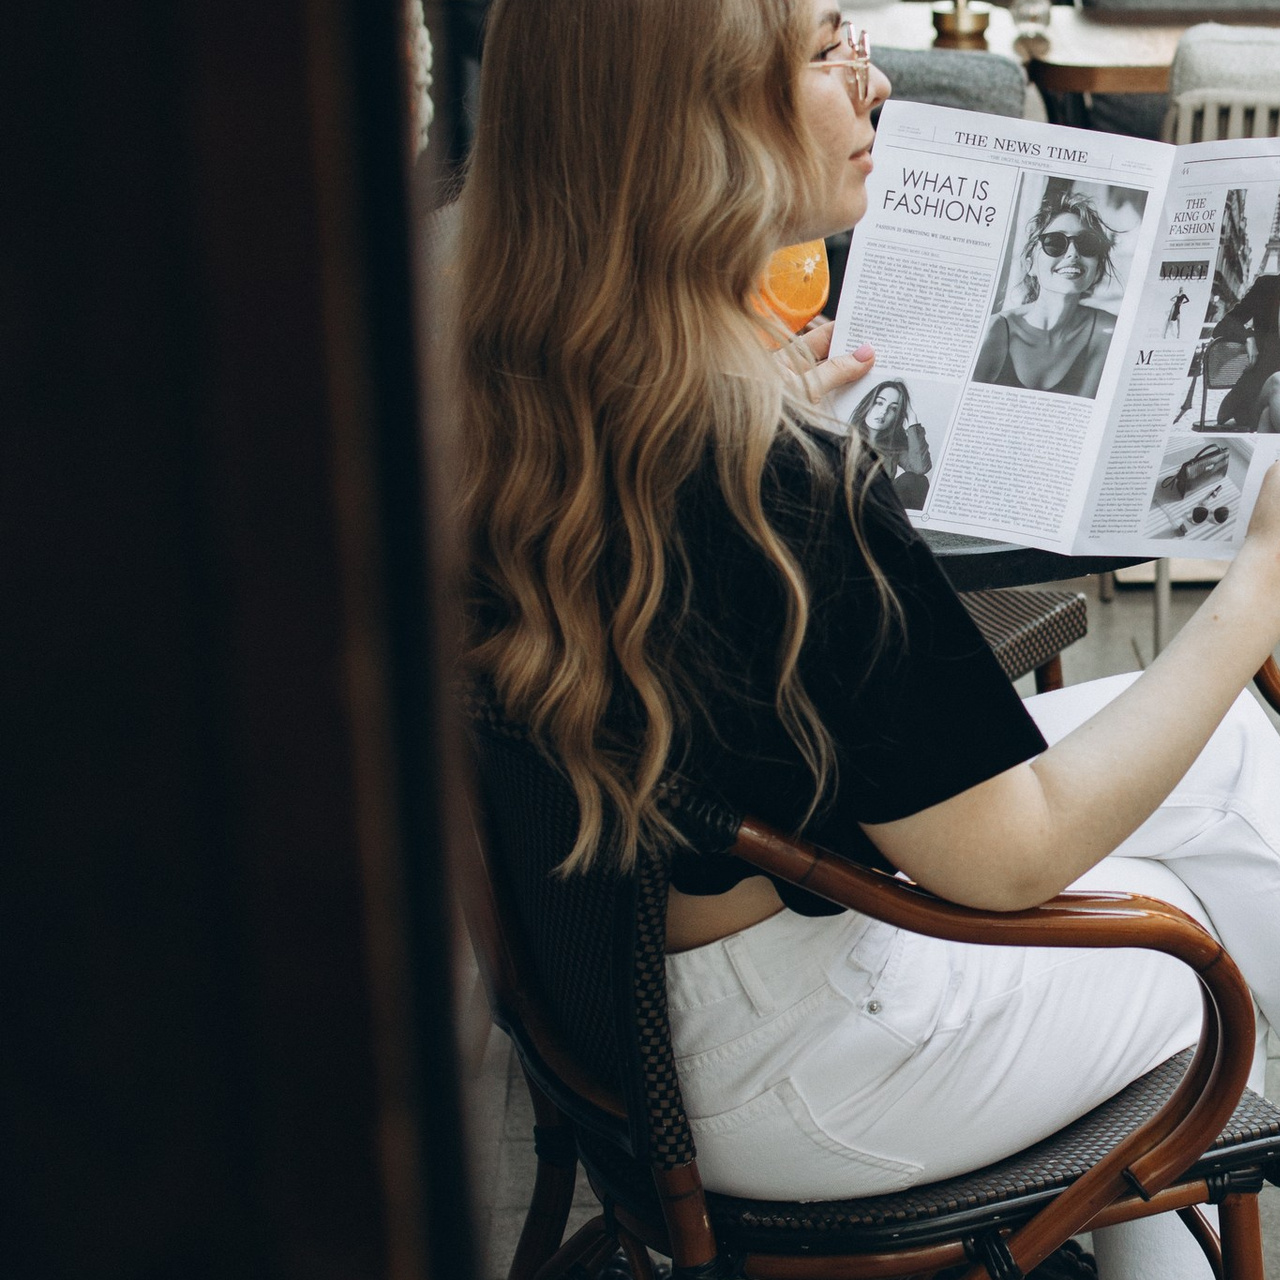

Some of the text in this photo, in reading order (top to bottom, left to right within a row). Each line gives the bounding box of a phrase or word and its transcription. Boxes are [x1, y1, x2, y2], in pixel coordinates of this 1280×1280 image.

[954, 131, 1089, 164] THE NEWS TIME
[903, 168, 989, 200] WHAT IS
[883, 190, 996, 227] FASHION?
[1186, 198, 1207, 210] THE
[1173, 209, 1217, 223] KING OF
[875, 223, 896, 231] FASHION
[903, 228, 930, 237] SOMETHING
[1169, 222, 1216, 235] FASHION
